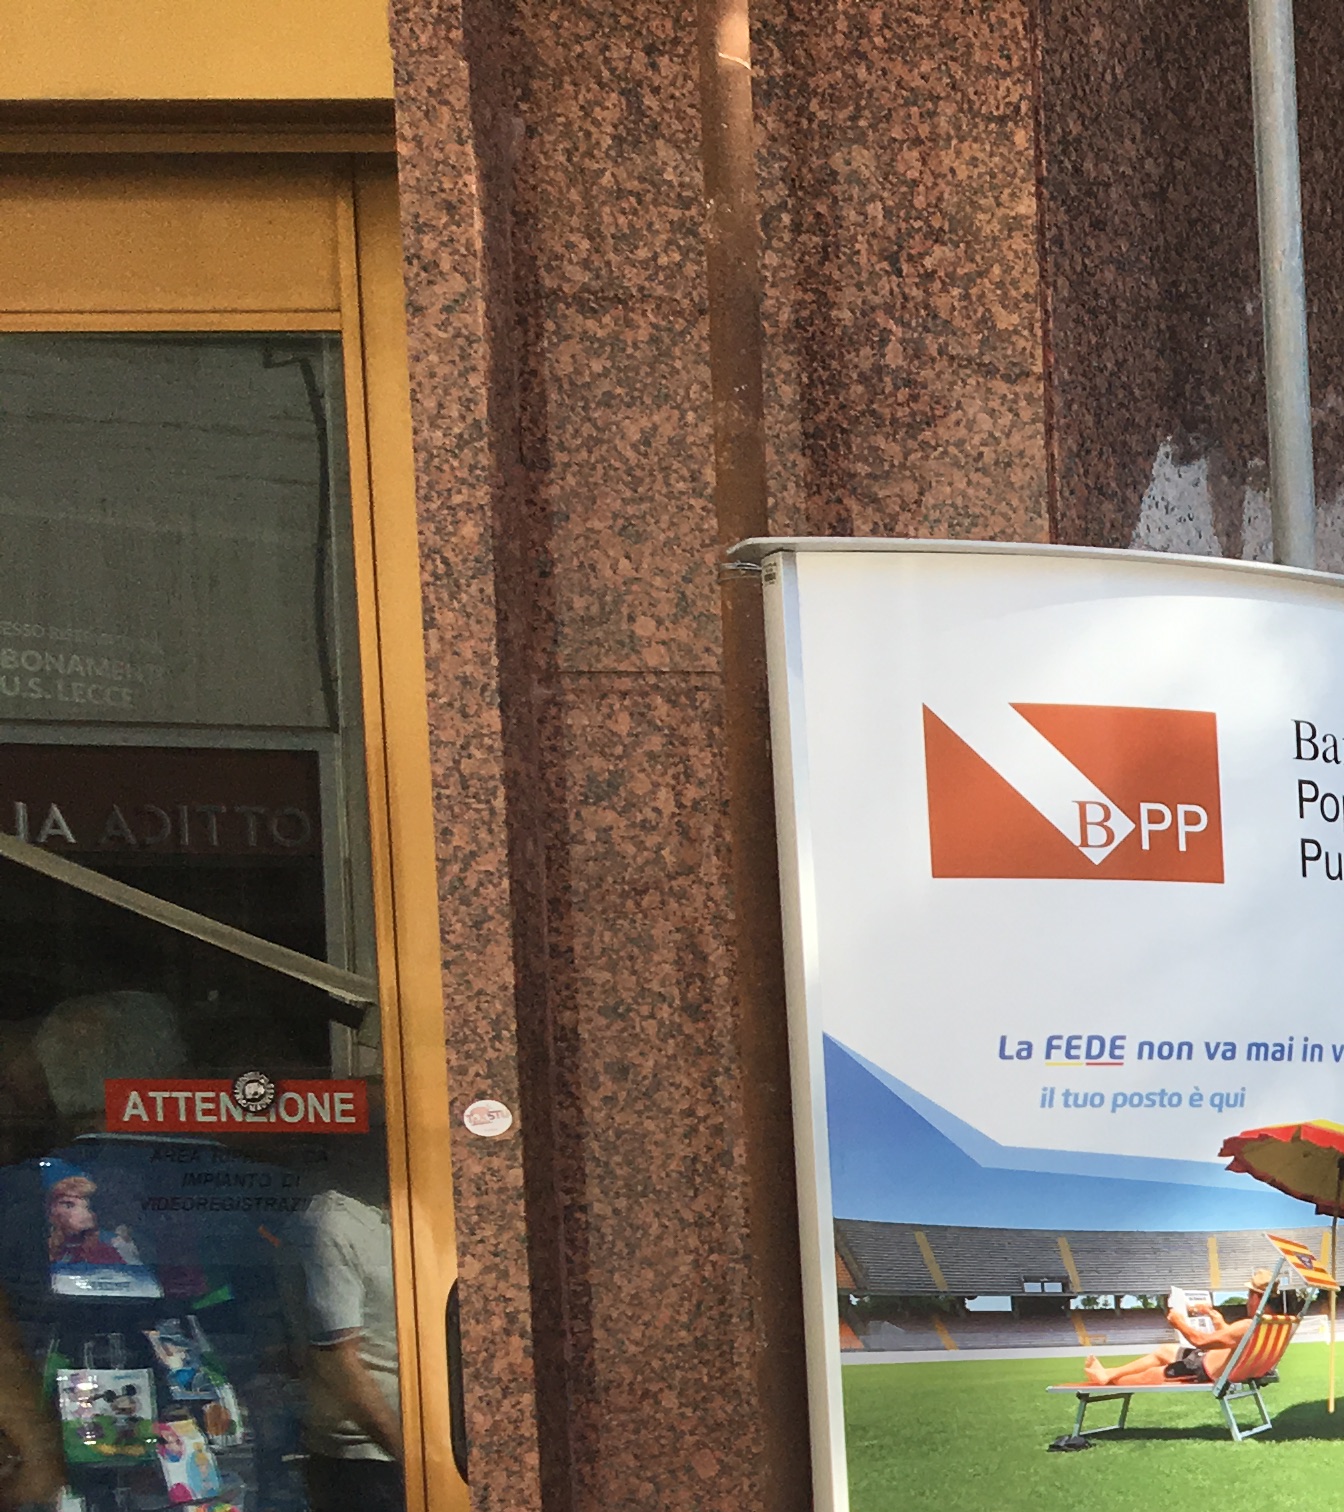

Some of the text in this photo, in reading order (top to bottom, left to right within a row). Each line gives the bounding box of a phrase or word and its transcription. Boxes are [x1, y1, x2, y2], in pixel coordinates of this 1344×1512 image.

[57, 679, 134, 708] LECCE
[997, 1034, 1034, 1061] La
[1044, 1034, 1127, 1062] FEDE
[1137, 1039, 1193, 1062] non
[1204, 1039, 1237, 1062] va
[1246, 1035, 1295, 1063] mai
[1301, 1036, 1324, 1063] in
[1039, 1086, 1246, 1114] il tuo posto è qui
[151, 1149, 201, 1164] AREA
[181, 1172, 301, 1189] IMPIANTO DI
[141, 1196, 347, 1213] VIDEOREGISTRAZIE
